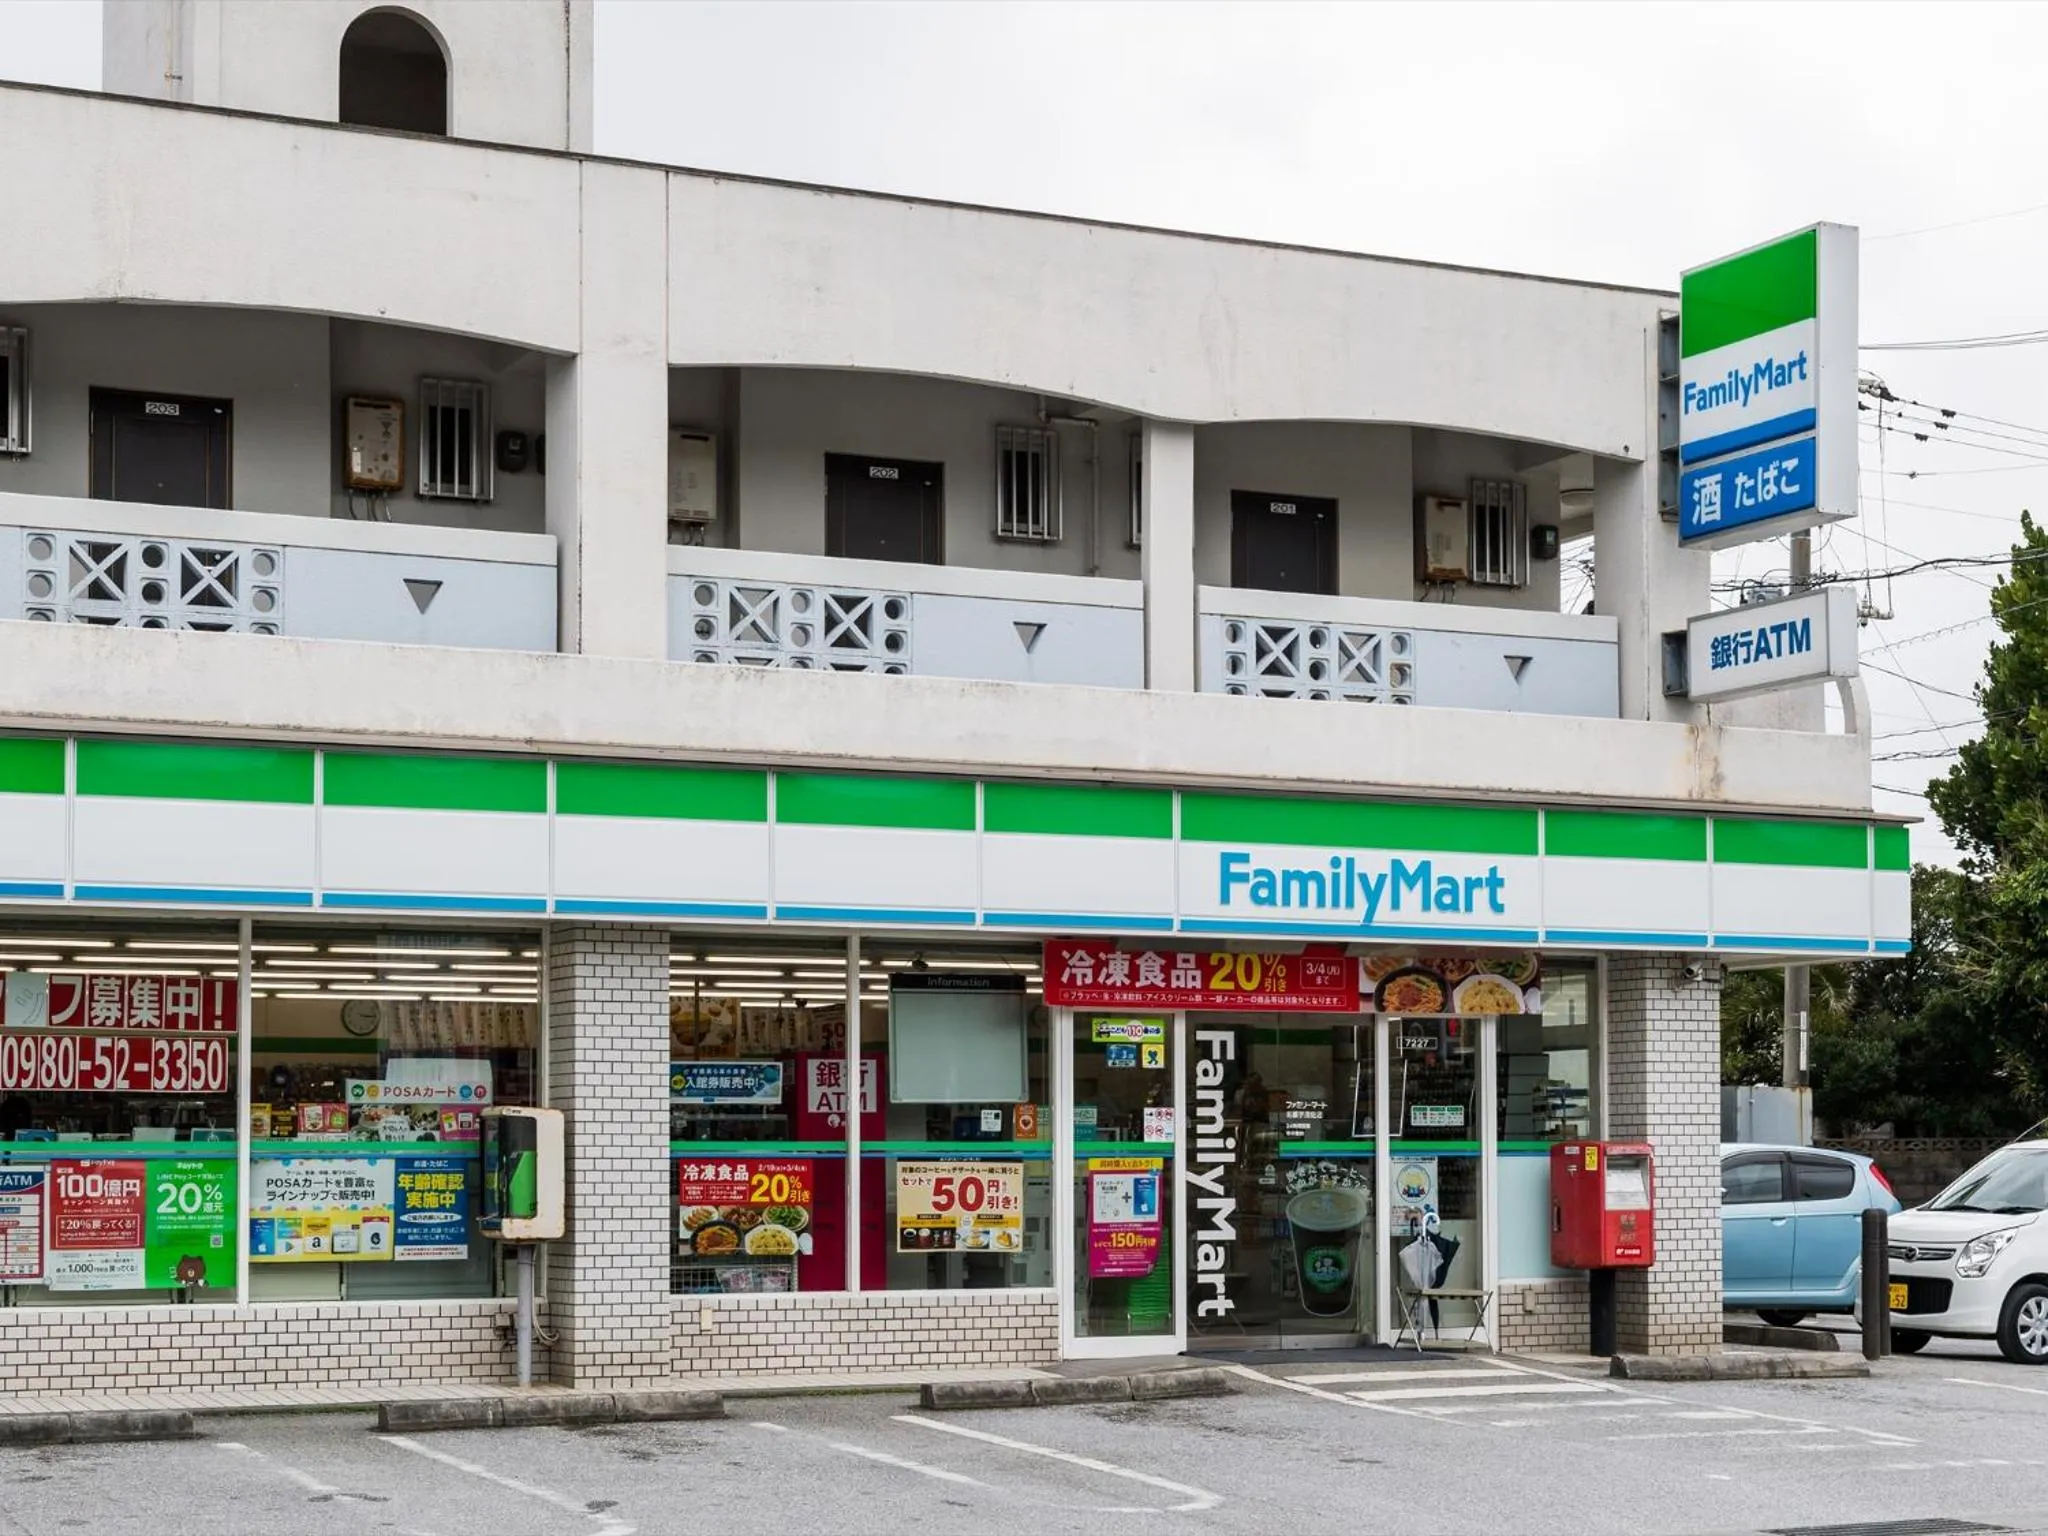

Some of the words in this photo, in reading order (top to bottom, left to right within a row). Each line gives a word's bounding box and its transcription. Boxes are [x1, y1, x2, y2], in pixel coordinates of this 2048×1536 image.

[1684, 350, 1808, 415] FamilyMart
[146, 402, 179, 415] 203
[871, 467, 899, 479] 202
[1692, 473, 1723, 526] 酒
[1734, 457, 1800, 511] たばこ
[1271, 502, 1297, 514] 201
[1710, 618, 1811, 671] 銀行ATM
[1219, 852, 1505, 926] FamilyMart
[1060, 949, 1203, 990] 冷凍食品
[1208, 951, 1287, 992] 20%
[927, 975, 991, 987] Information
[1263, 978, 1288, 993] 引き
[1405, 1038, 1429, 1048] 7227
[3, 1036, 223, 1090] 0980-52-3350
[383, 1086, 456, 1097] POSAカード
[1285, 1101, 1328, 1110] ファミリーマート
[683, 1164, 750, 1182] 冷凍食品
[1186, 1030, 1236, 1317] FamilyMart
[56, 1174, 140, 1198] 100億円
[266, 1177, 375, 1188] POSAカードを豊富な
[398, 1173, 464, 1191] 年齢確認
[751, 1174, 803, 1203] 20%
[156, 1183, 223, 1214] 20%
[266, 1189, 376, 1201] ラインナップで販売中!
[406, 1191, 455, 1208] 実施中
[790, 1189, 811, 1203] 引き
[931, 1176, 985, 1212] 50
[987, 1180, 1000, 1193] 円
[987, 1195, 1018, 1209] 引き!
